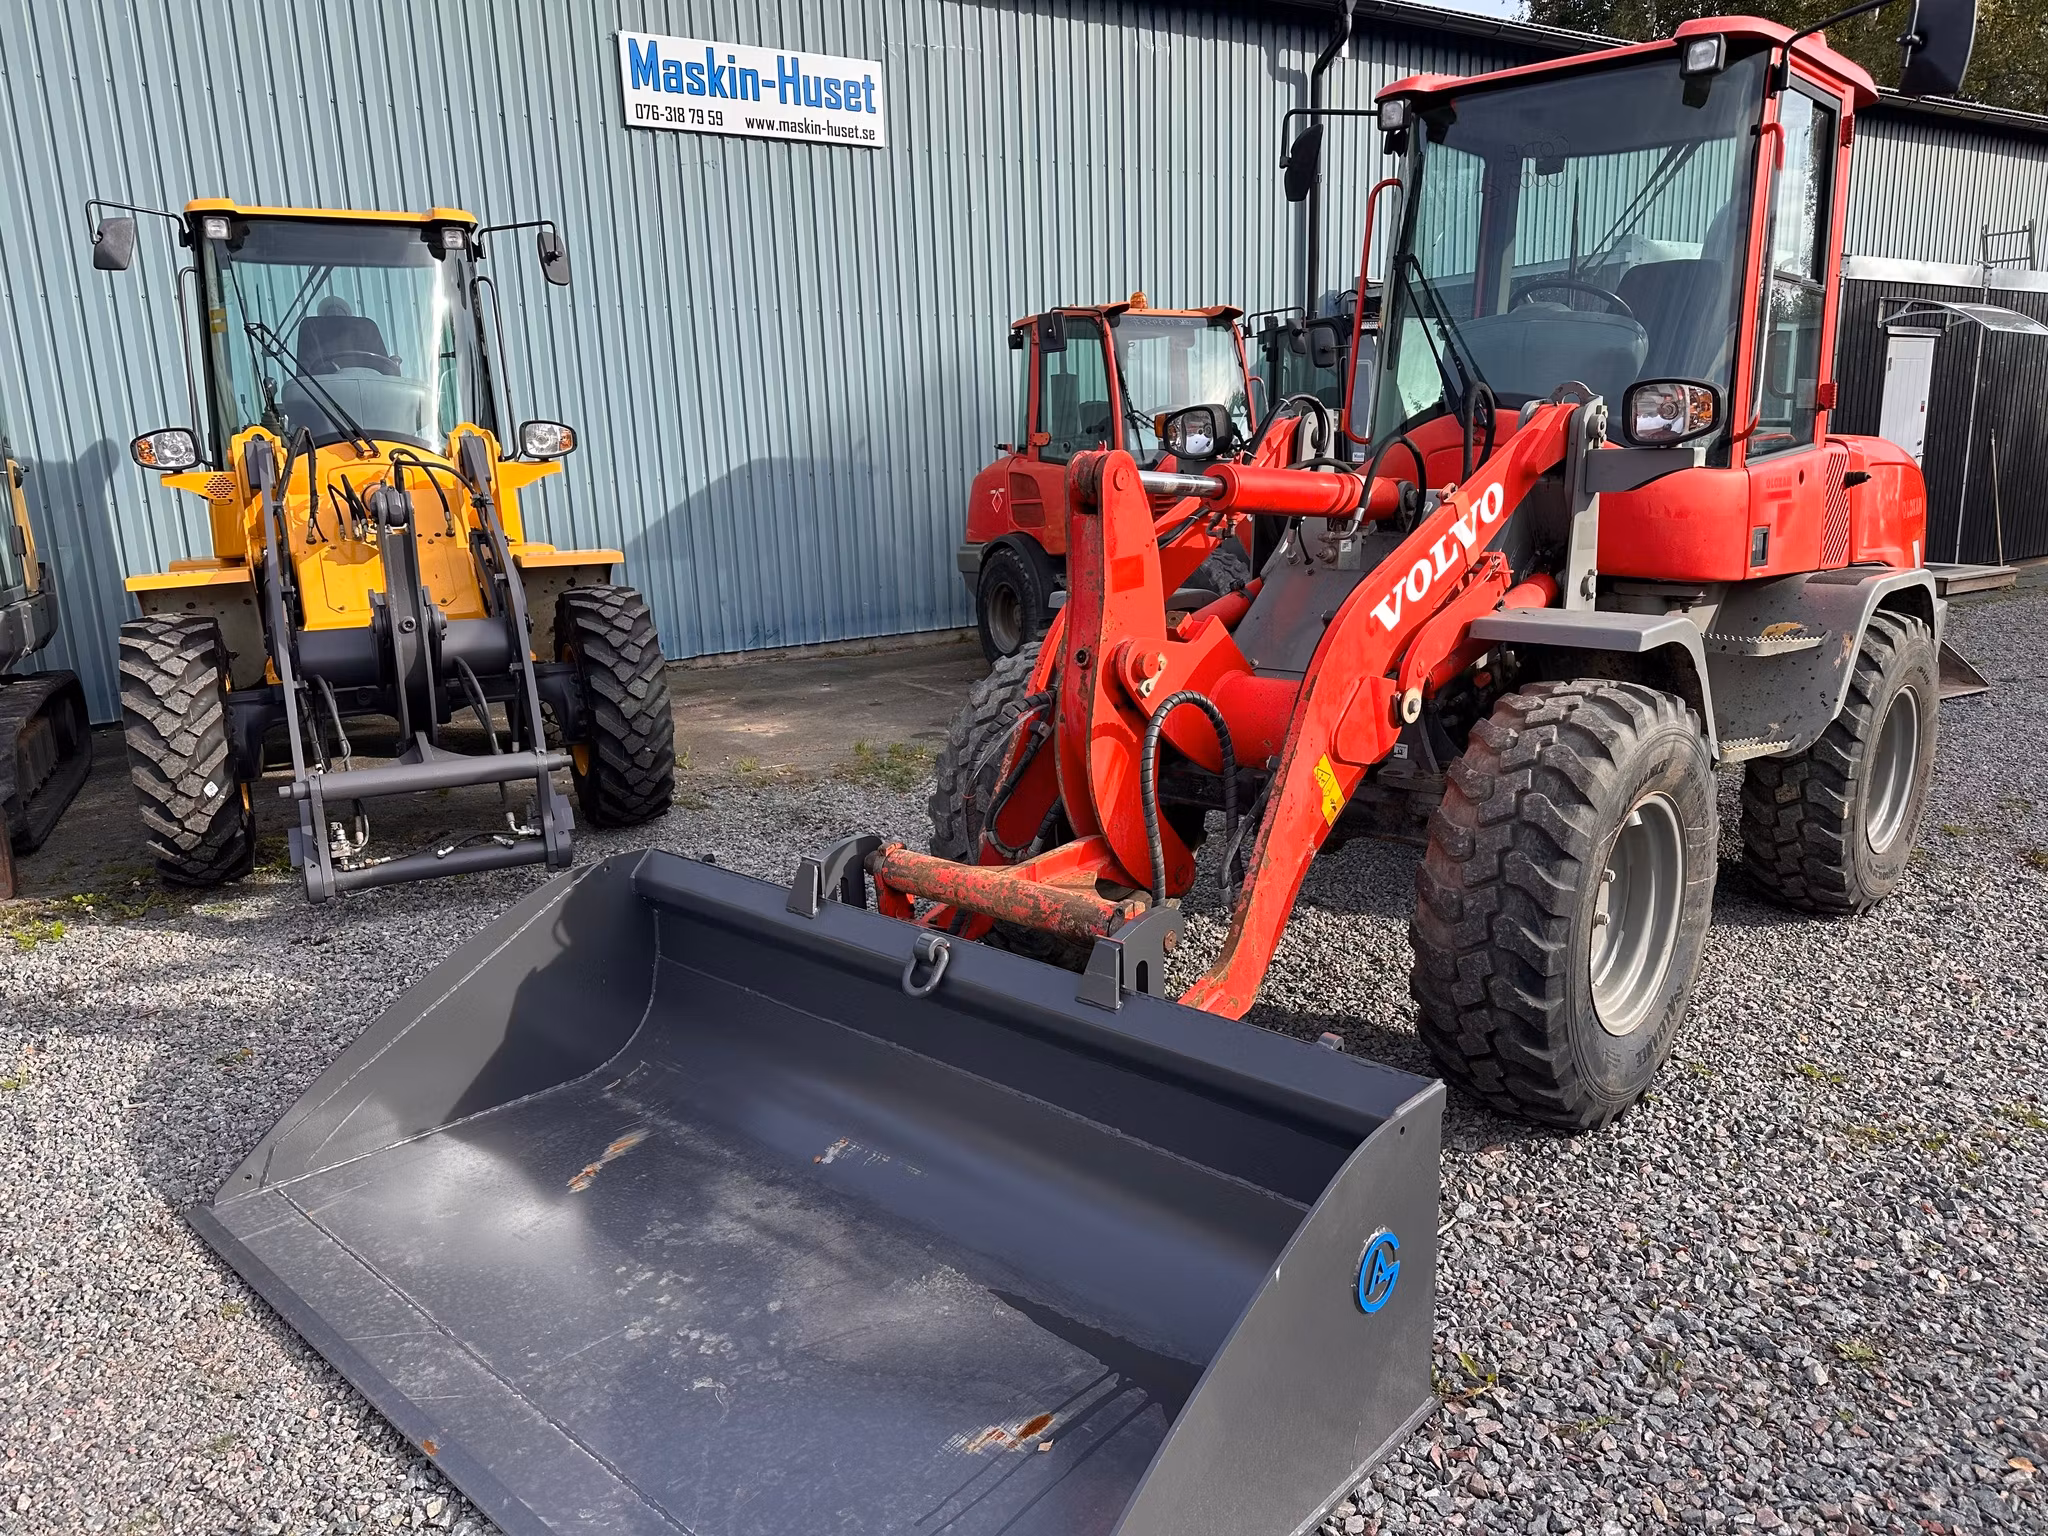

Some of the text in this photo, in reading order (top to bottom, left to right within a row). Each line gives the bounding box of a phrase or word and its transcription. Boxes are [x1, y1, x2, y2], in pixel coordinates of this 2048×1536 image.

[628, 38, 876, 114] Maskin-Huset
[635, 103, 723, 126] 076-318 79 59
[745, 117, 875, 141] www.maskin-huset.se
[1370, 482, 1504, 632] VOLVO
